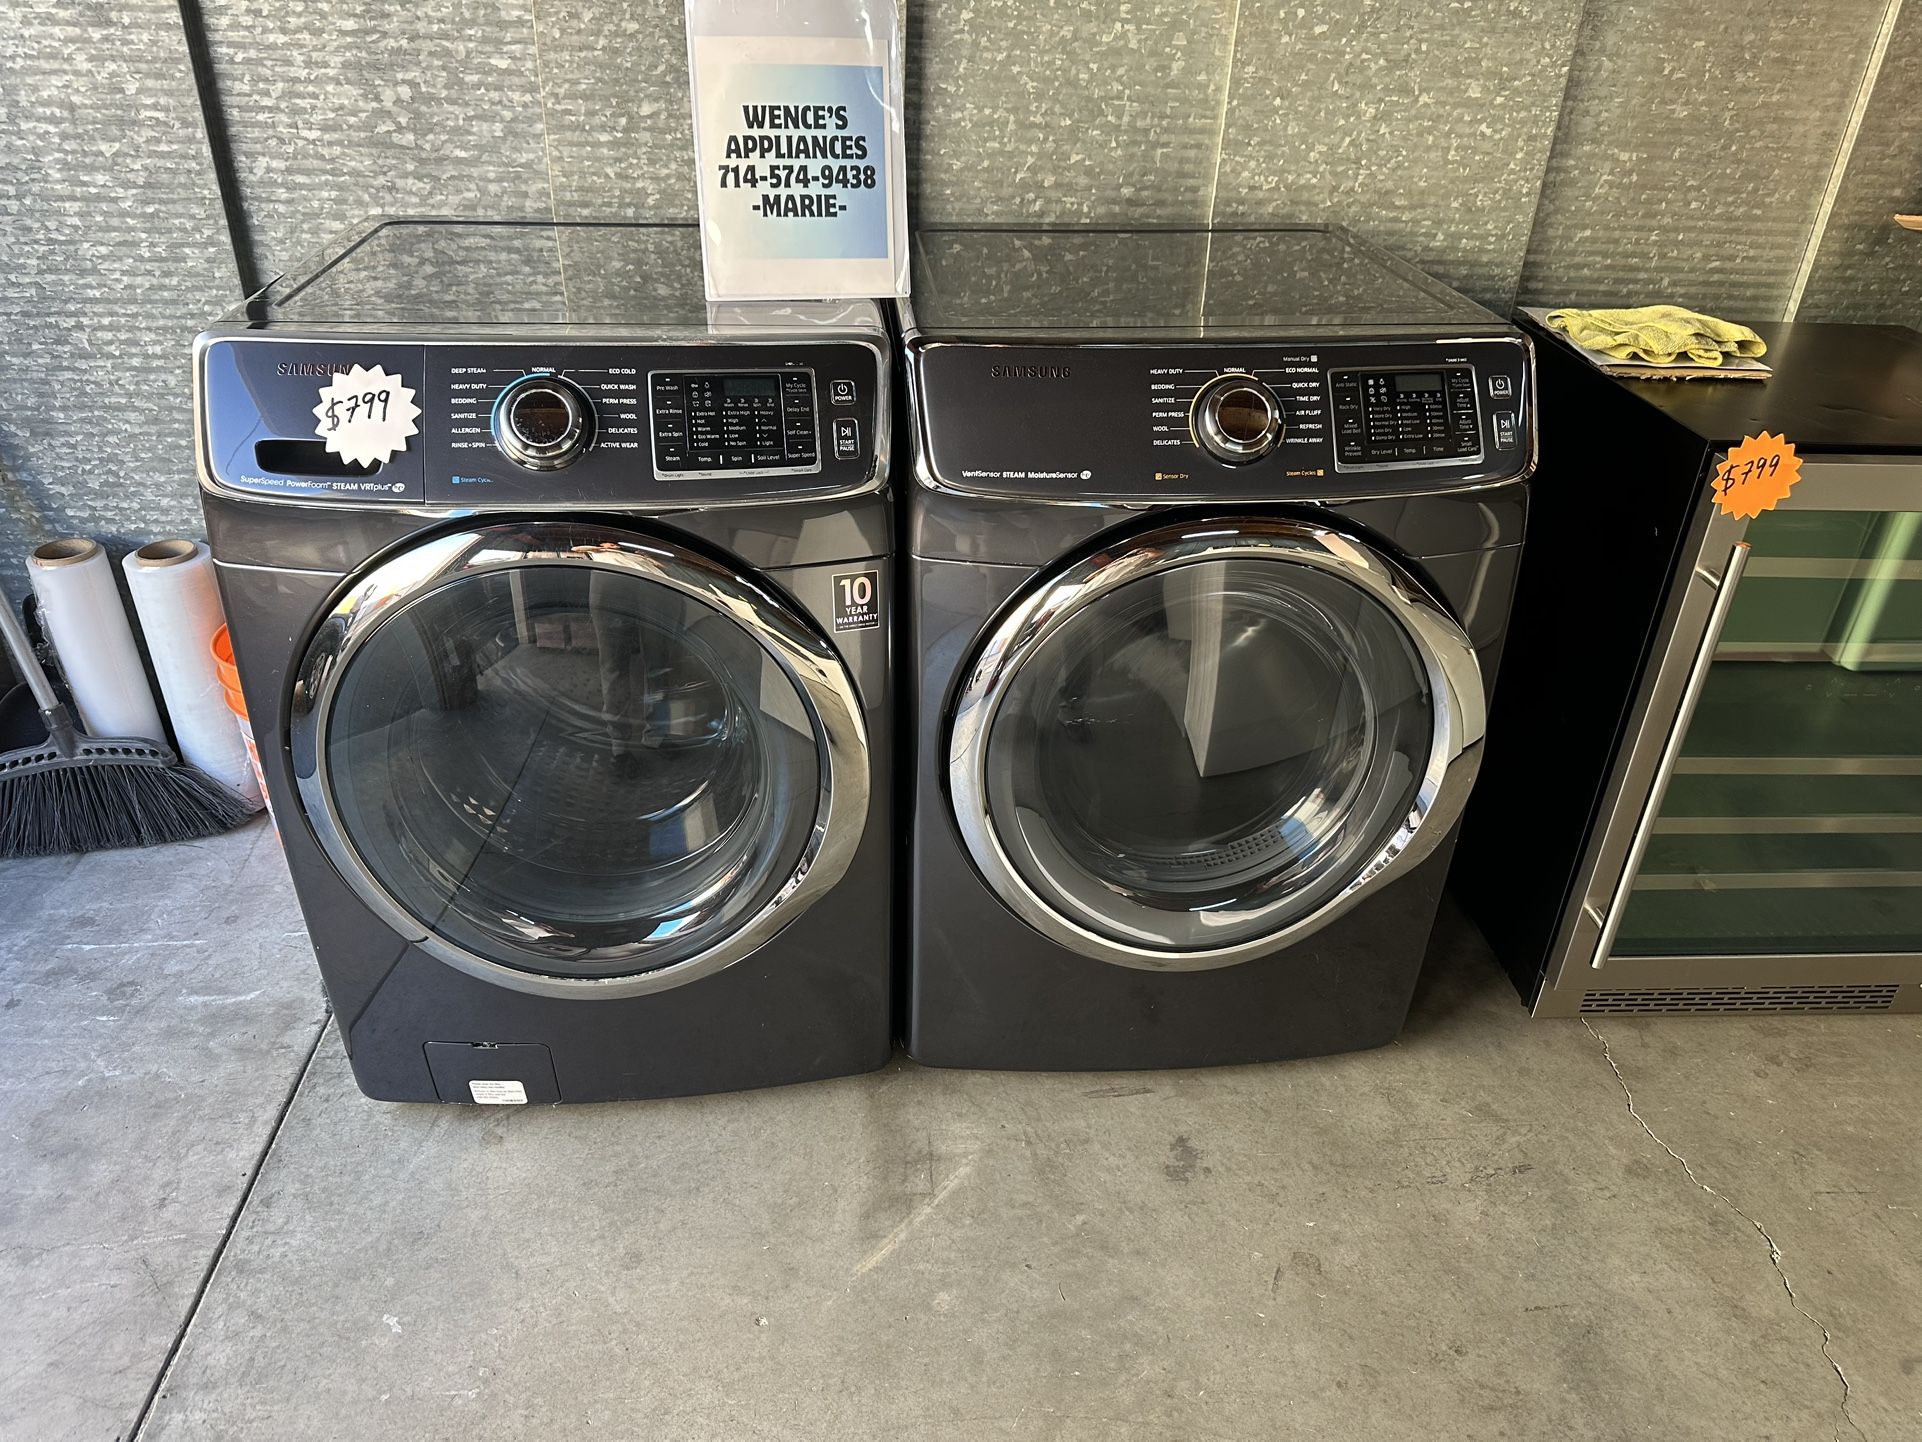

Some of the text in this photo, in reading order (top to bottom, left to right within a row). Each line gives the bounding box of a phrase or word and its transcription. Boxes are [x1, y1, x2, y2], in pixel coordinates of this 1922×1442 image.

[742, 105, 847, 129] WENCE'S
[726, 136, 867, 159] APPLIANCES
[718, 165, 876, 189] 714-574-9438
[752, 194, 847, 217] -MARIE-
[277, 363, 352, 376] SAMSUN
[991, 365, 1071, 378] SAMSUNG
[325, 390, 391, 431] $799
[240, 476, 283, 486] SuperSpeed
[962, 470, 1000, 478] VentSensor
[1721, 454, 1780, 496] $799
[840, 577, 871, 606] 10
[836, 613, 877, 624] WARRANTY
[846, 606, 868, 615] YEAR
